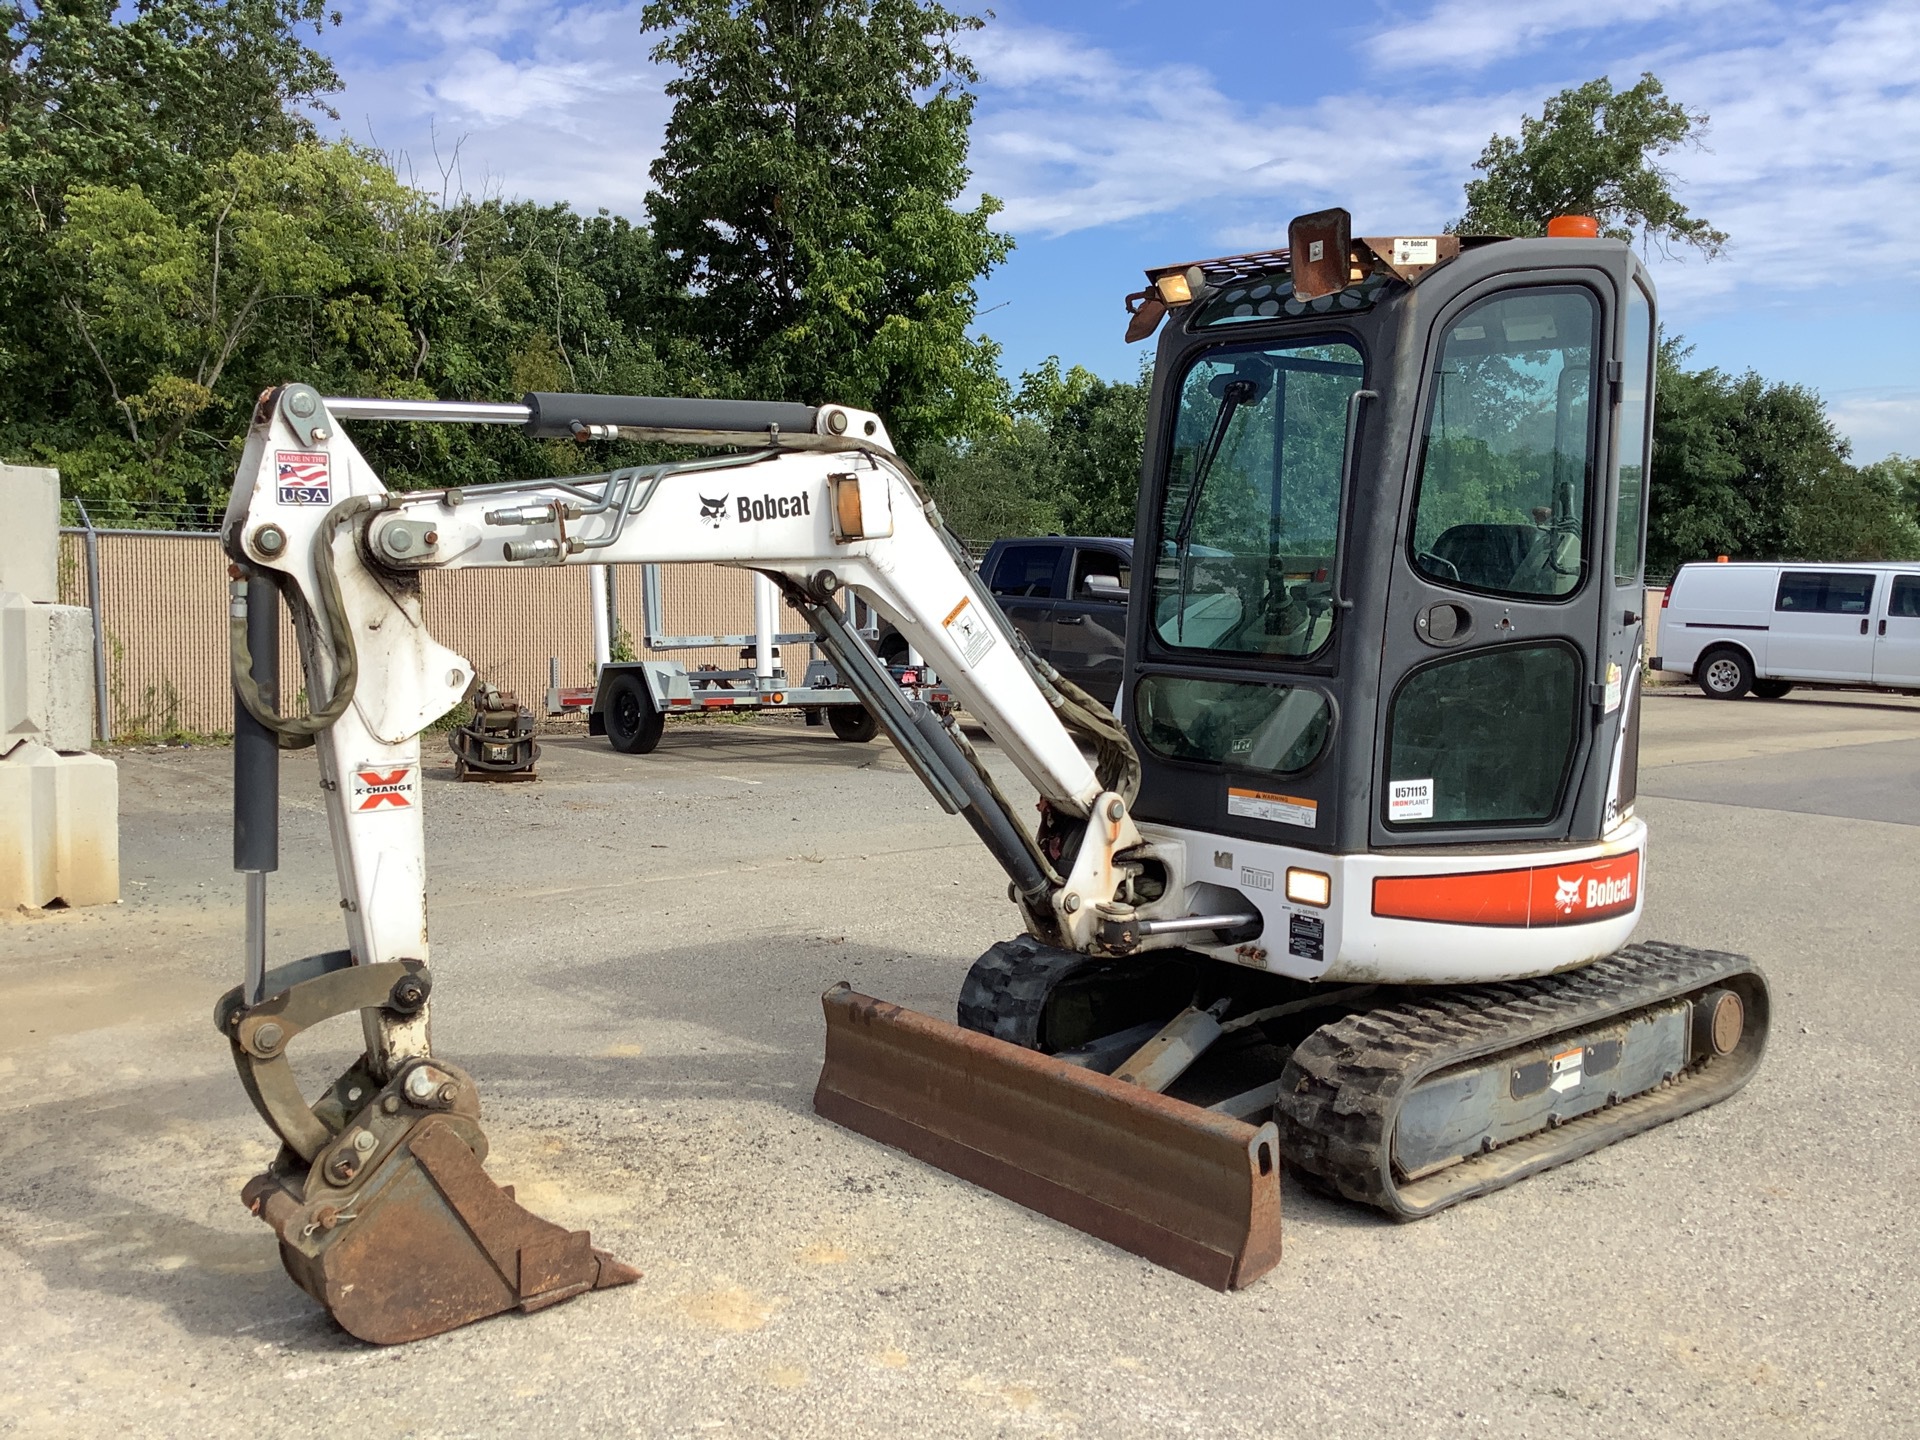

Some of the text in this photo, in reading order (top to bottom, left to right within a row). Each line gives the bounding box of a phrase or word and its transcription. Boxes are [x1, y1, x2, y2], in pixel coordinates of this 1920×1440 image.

[281, 488, 328, 502] USA
[736, 491, 810, 523] Bobcat
[355, 784, 413, 795] X-CHANGE
[1395, 786, 1428, 798] U571113
[1262, 793, 1289, 803] WARNING
[1392, 799, 1430, 807] IRONPLANET
[1586, 872, 1632, 909] Bobcat
